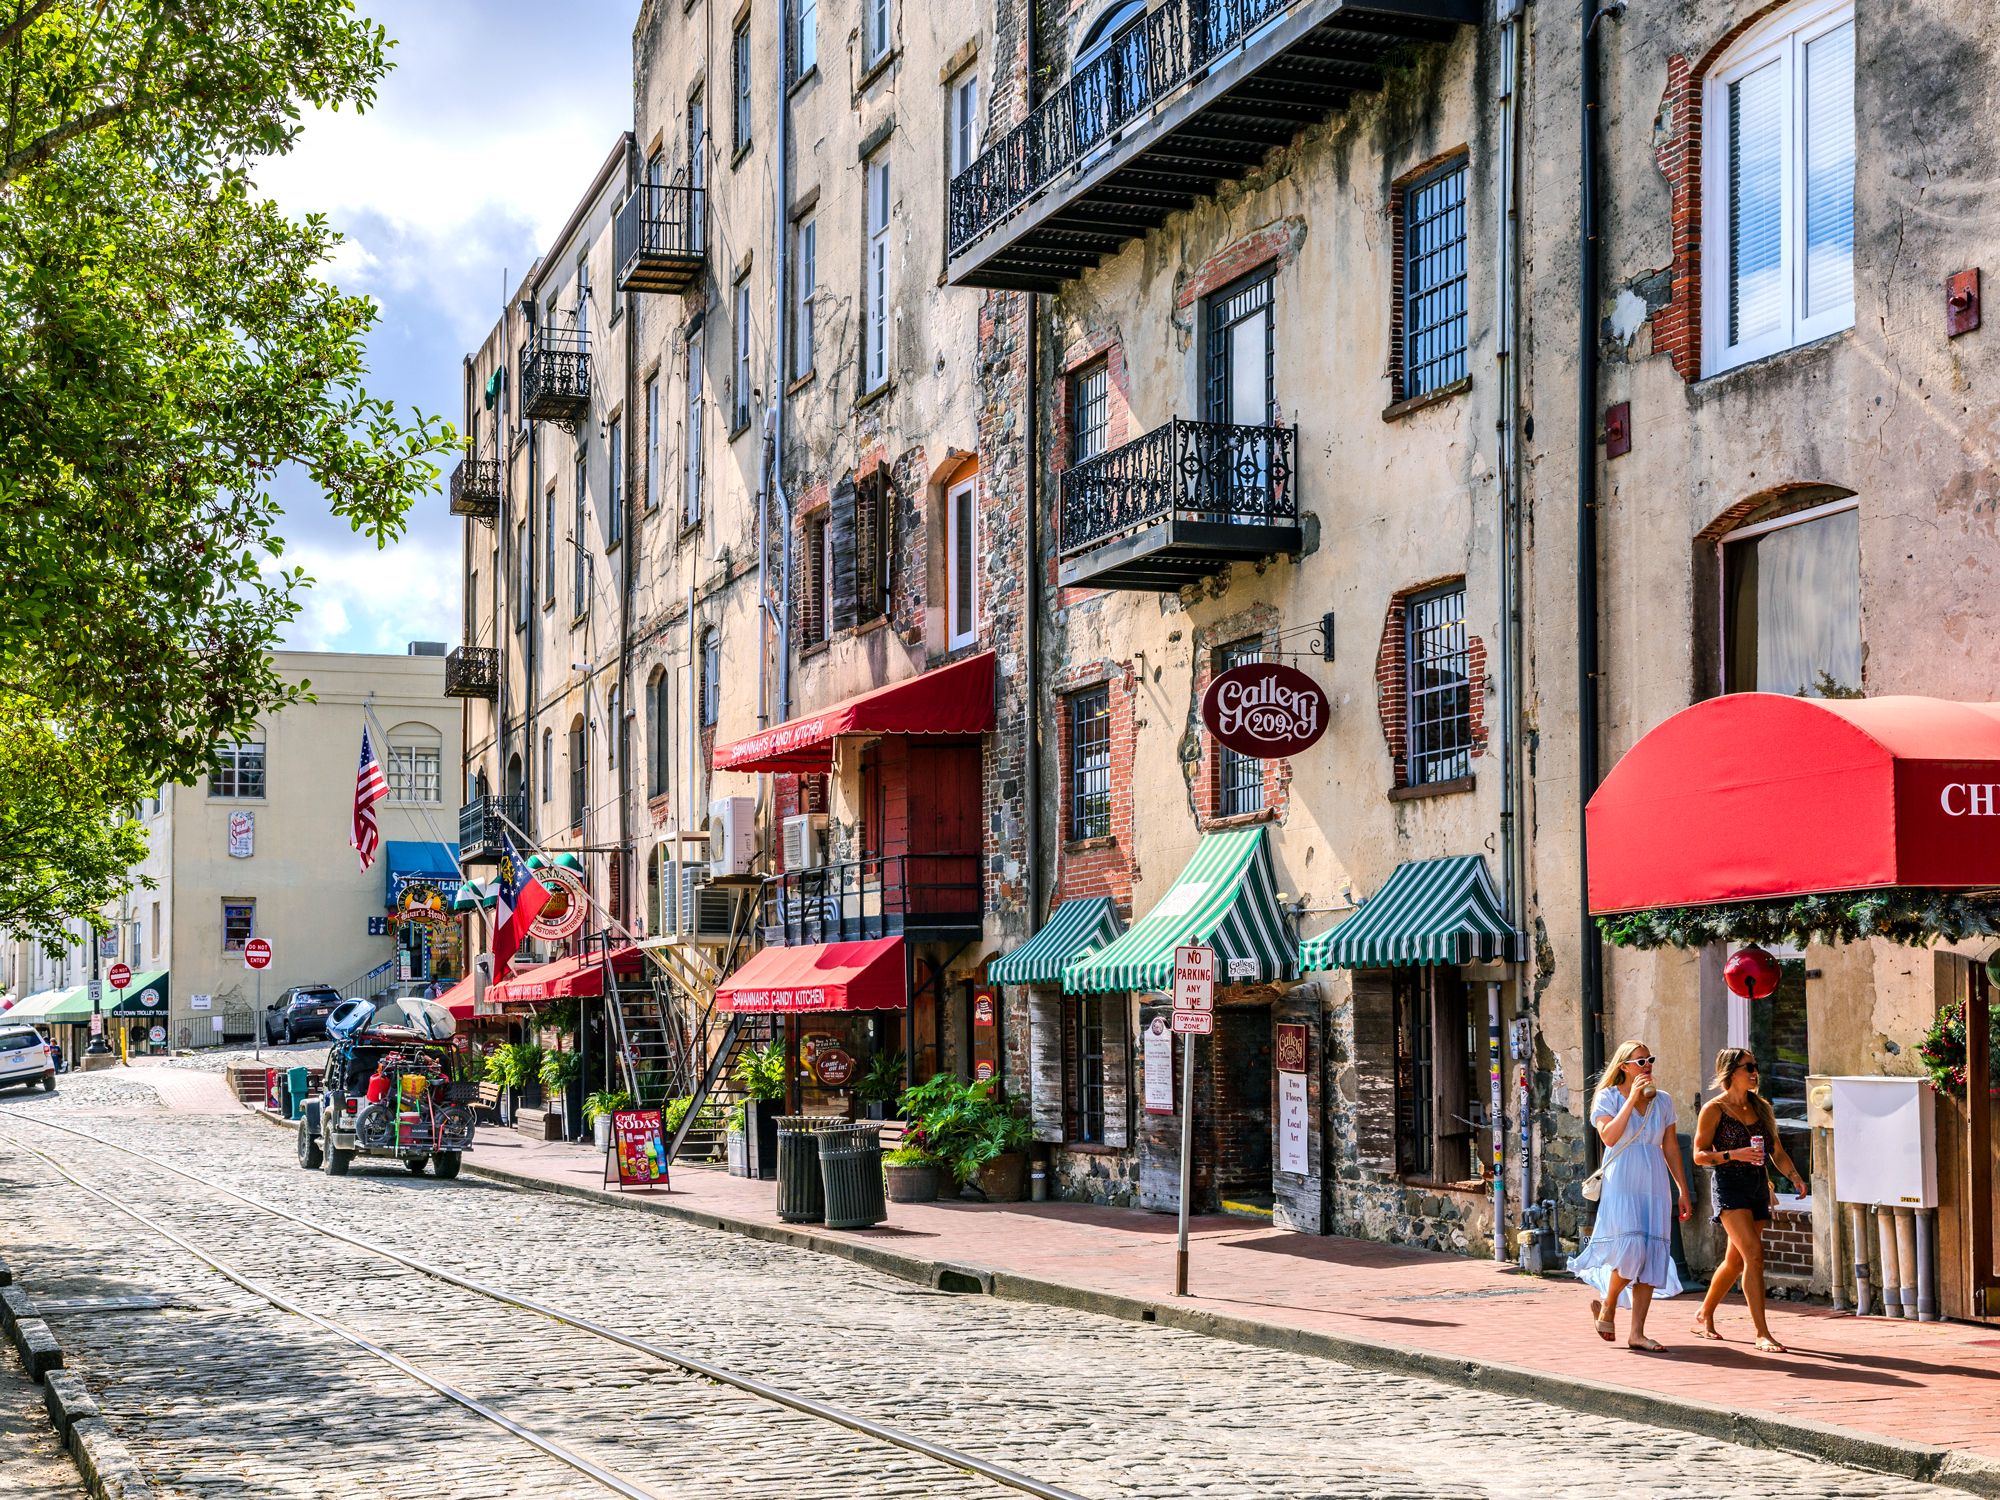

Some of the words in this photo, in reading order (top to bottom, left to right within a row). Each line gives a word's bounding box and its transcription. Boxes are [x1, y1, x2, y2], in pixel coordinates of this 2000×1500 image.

[1217, 675, 1319, 739] Gallery
[1252, 712, 1287, 734] 209
[731, 735, 769, 759] SAVANNAH'S
[769, 729, 794, 748] CANDY
[793, 720, 825, 742] KITCHEN
[1940, 783, 2000, 816] CH
[401, 909, 426, 920] Boar's
[427, 908, 447, 922] Head
[533, 924, 559, 936] HISTORIC
[560, 905, 584, 934] WATERFRONT
[1187, 952, 1202, 964] NO
[1177, 968, 1211, 981] PARKING
[1186, 984, 1201, 993] ANY
[732, 991, 770, 1006] SAVANNAH'S
[771, 990, 794, 1006] CANDY
[795, 988, 825, 1005] KITCHEN
[1185, 997, 1201, 1006] TIME
[1176, 1015, 1209, 1023] TOW-AWAY
[1278, 1031, 1303, 1064] Gallery
[820, 1060, 839, 1068] Come
[838, 1063, 848, 1071] in!
[1288, 1079, 1300, 1089] Two
[1285, 1091, 1303, 1102] Floors
[1291, 1106, 1298, 1115] of
[615, 1113, 637, 1123] Craft
[1287, 1118, 1302, 1129] Local
[616, 1119, 660, 1130] SODAS
[1290, 1132, 1299, 1142] Art
